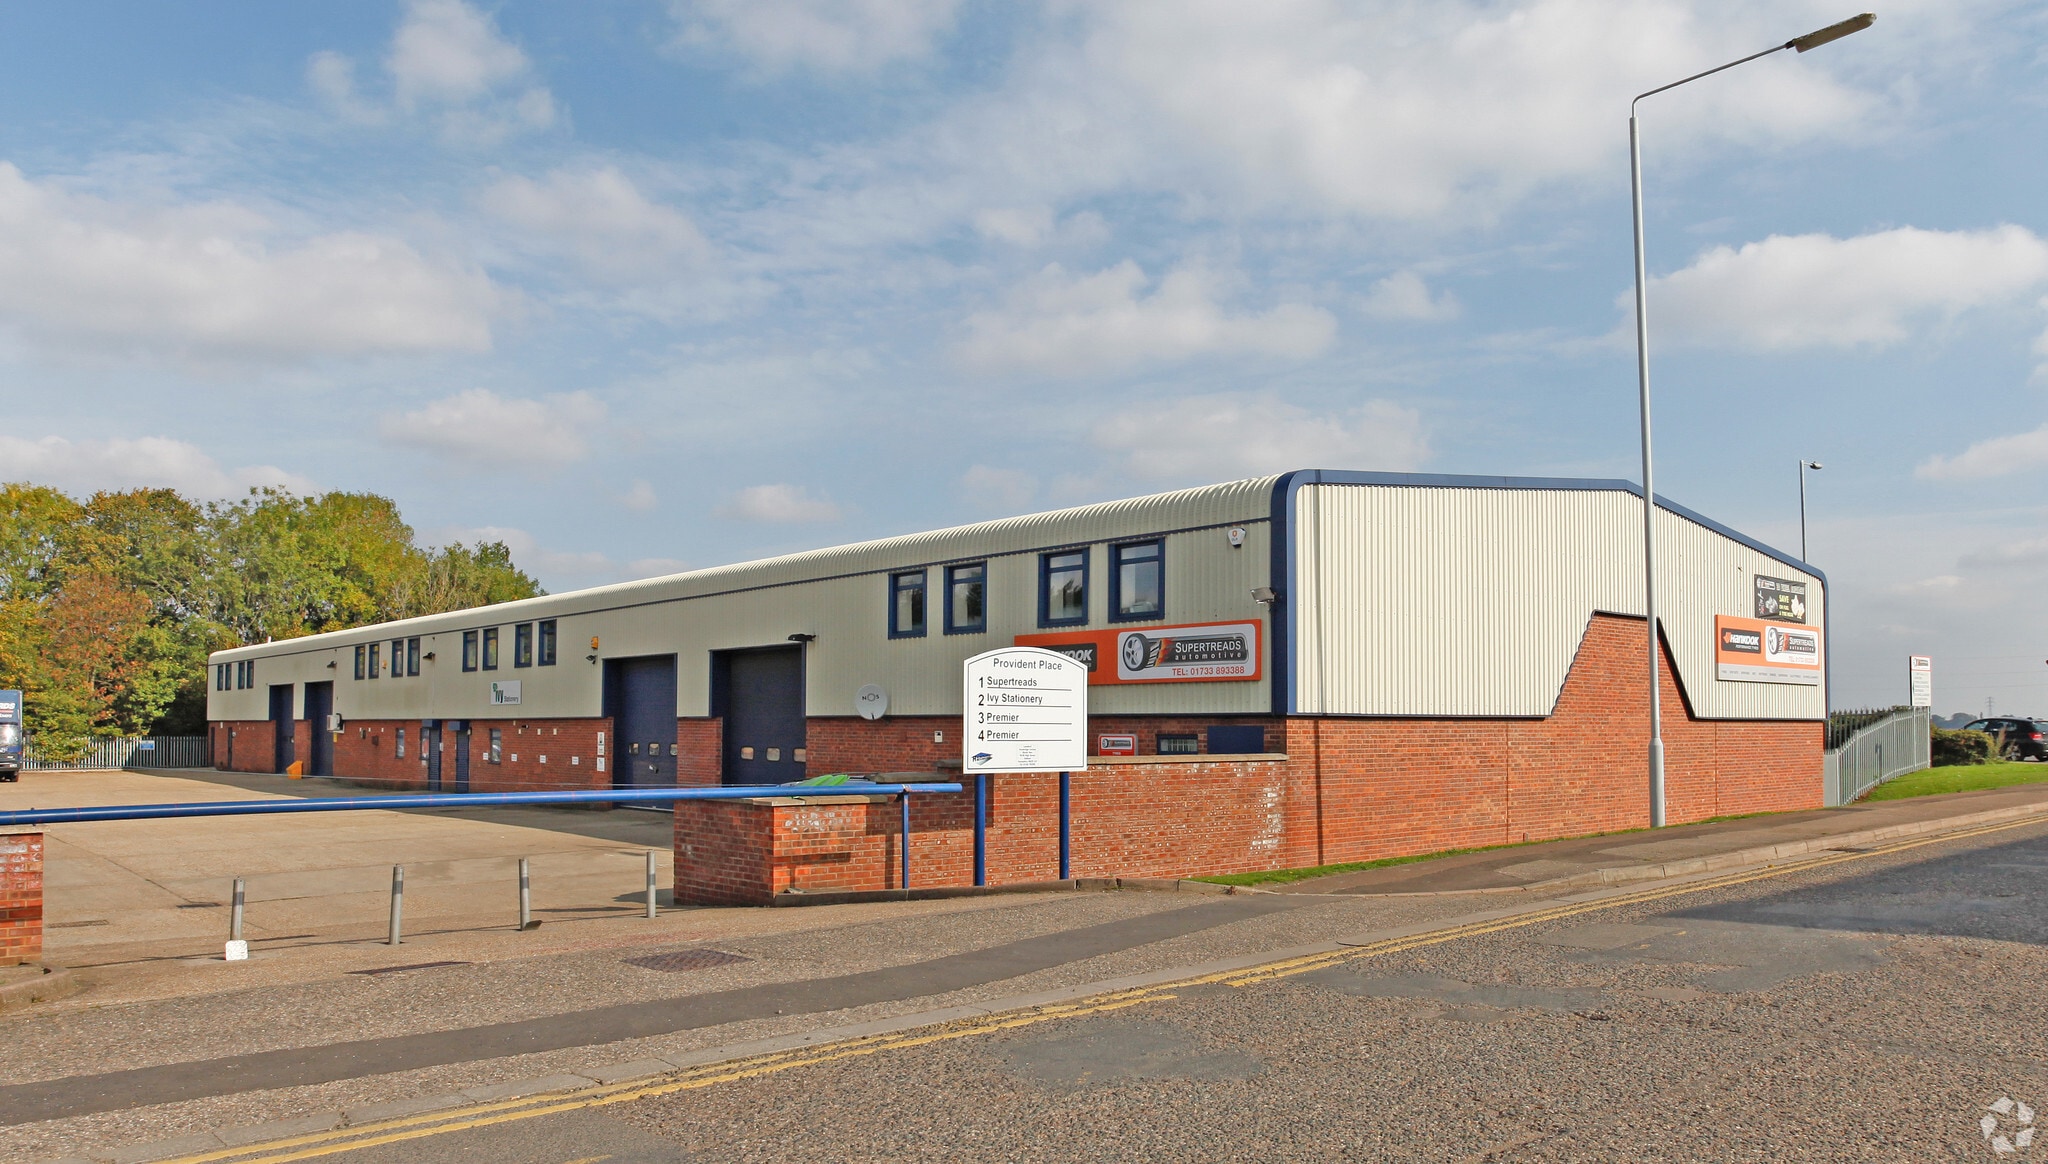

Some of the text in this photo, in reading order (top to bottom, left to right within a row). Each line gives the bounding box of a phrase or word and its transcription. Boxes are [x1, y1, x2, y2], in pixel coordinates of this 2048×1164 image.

[1175, 641, 1241, 653] SUPERTREADS
[1175, 652, 1241, 660] automotive
[993, 658, 1062, 670] Provident Place
[1172, 666, 1245, 676] TEL: 01733 893388
[978, 676, 1037, 688] 1 Supertreads
[978, 693, 1043, 706] 2 Ivy Stationery
[978, 712, 1019, 723] 3 Premier
[978, 730, 1019, 741] 4 Premier
